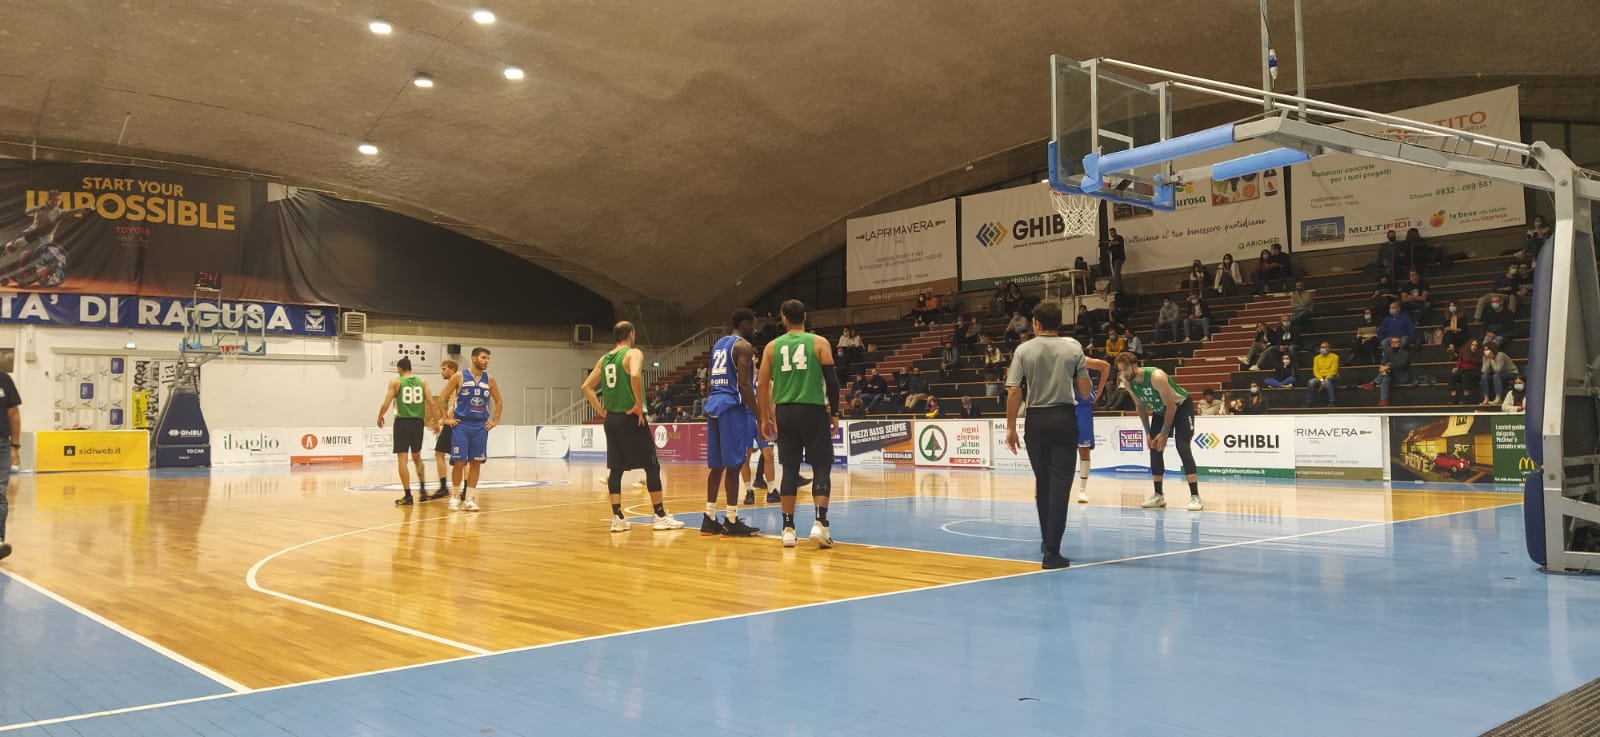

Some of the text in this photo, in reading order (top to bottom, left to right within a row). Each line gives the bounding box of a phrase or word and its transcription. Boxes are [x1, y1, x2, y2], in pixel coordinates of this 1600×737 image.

[1344, 163, 1376, 174] concrete
[1329, 176, 1342, 184] per
[82, 177, 184, 197] START YOUR
[1176, 194, 1206, 207] urosa
[115, 226, 151, 235] TOYOTA
[1224, 217, 1267, 234] quotidiano
[1348, 220, 1412, 234] MULTIFIDI
[79, 296, 119, 323] DI
[138, 300, 292, 331] RAGUSA
[711, 348, 728, 376] 22
[780, 344, 808, 372] 14
[604, 363, 617, 389] 8
[402, 386, 424, 404] 88
[961, 424, 980, 434] ogni
[1294, 427, 1357, 438] RIMAVERA
[956, 433, 980, 441] giorno
[1120, 431, 1142, 440] Santa
[1224, 434, 1279, 449] GHIBLI
[1120, 440, 1142, 448] Maria
[79, 447, 121, 455] sidiweb.it
[956, 447, 980, 455] fianco
